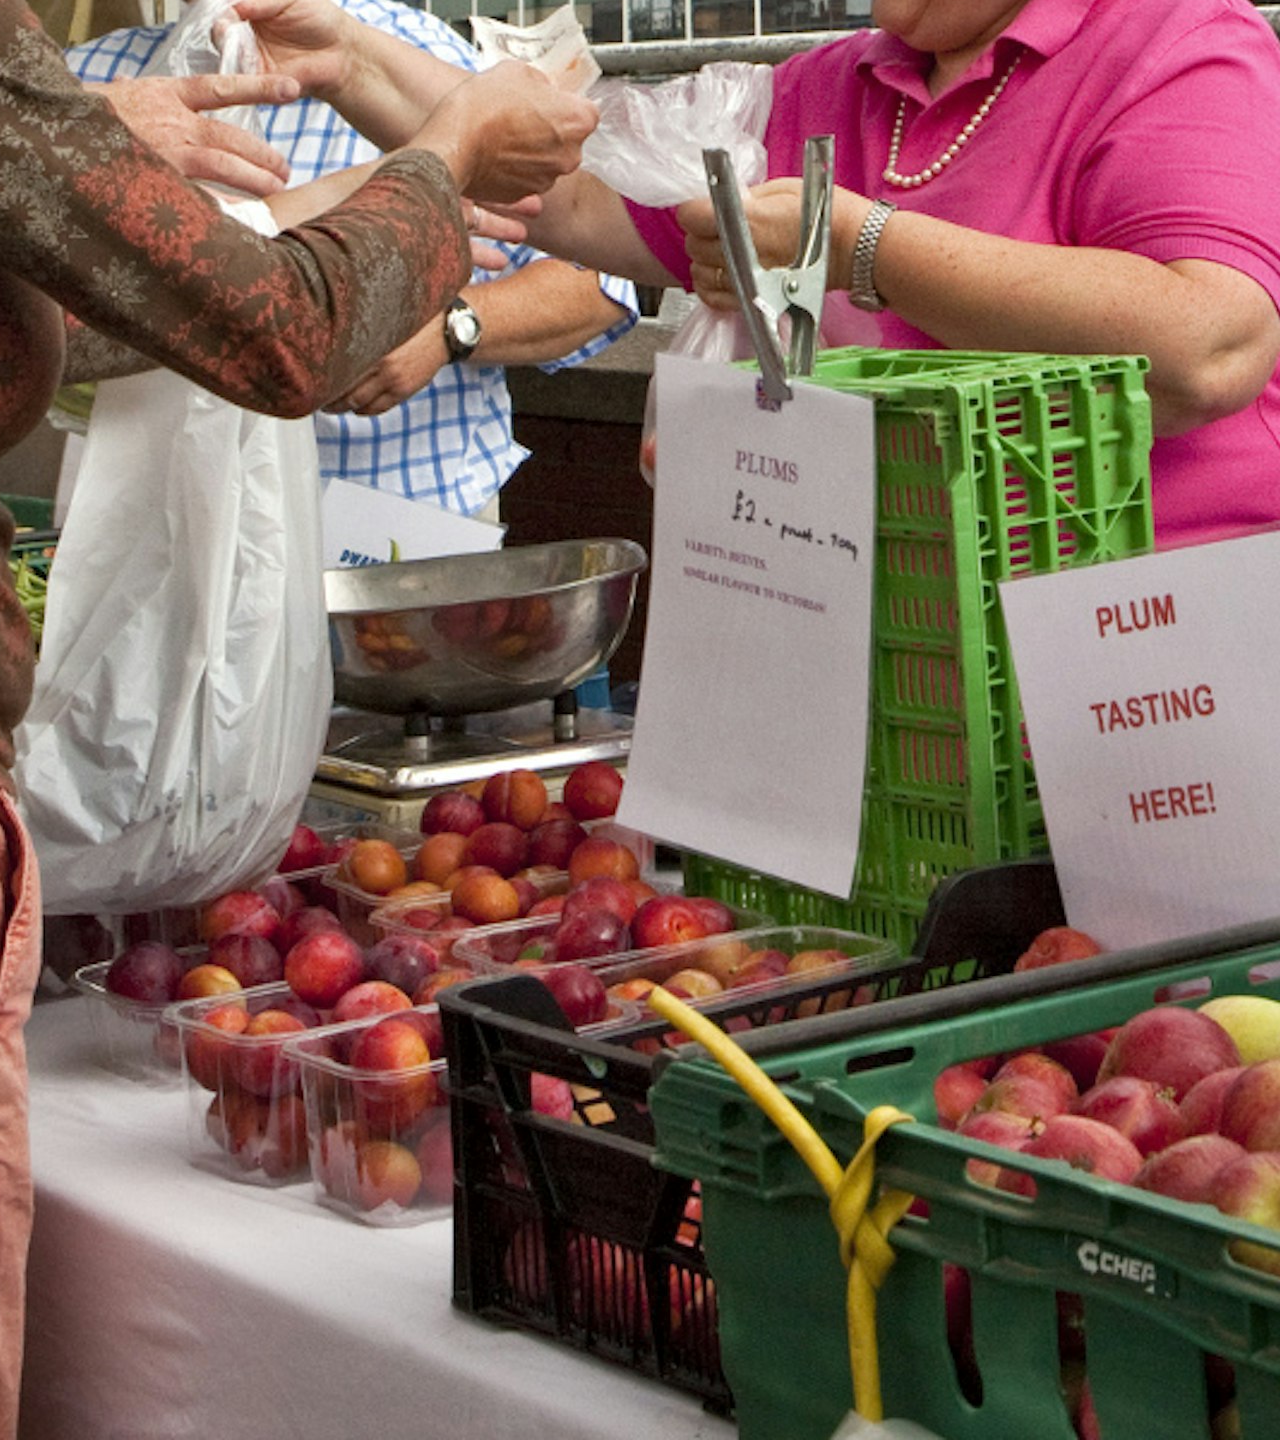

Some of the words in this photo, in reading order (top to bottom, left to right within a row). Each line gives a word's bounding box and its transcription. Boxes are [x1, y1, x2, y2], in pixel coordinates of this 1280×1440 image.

[734, 449, 799, 485] PLUMS
[731, 489, 756, 523] £2
[683, 566, 719, 586] SIMILAR
[1095, 593, 1176, 638] PLUM
[1090, 683, 1216, 734] TASTING
[1129, 781, 1217, 824] HERE!
